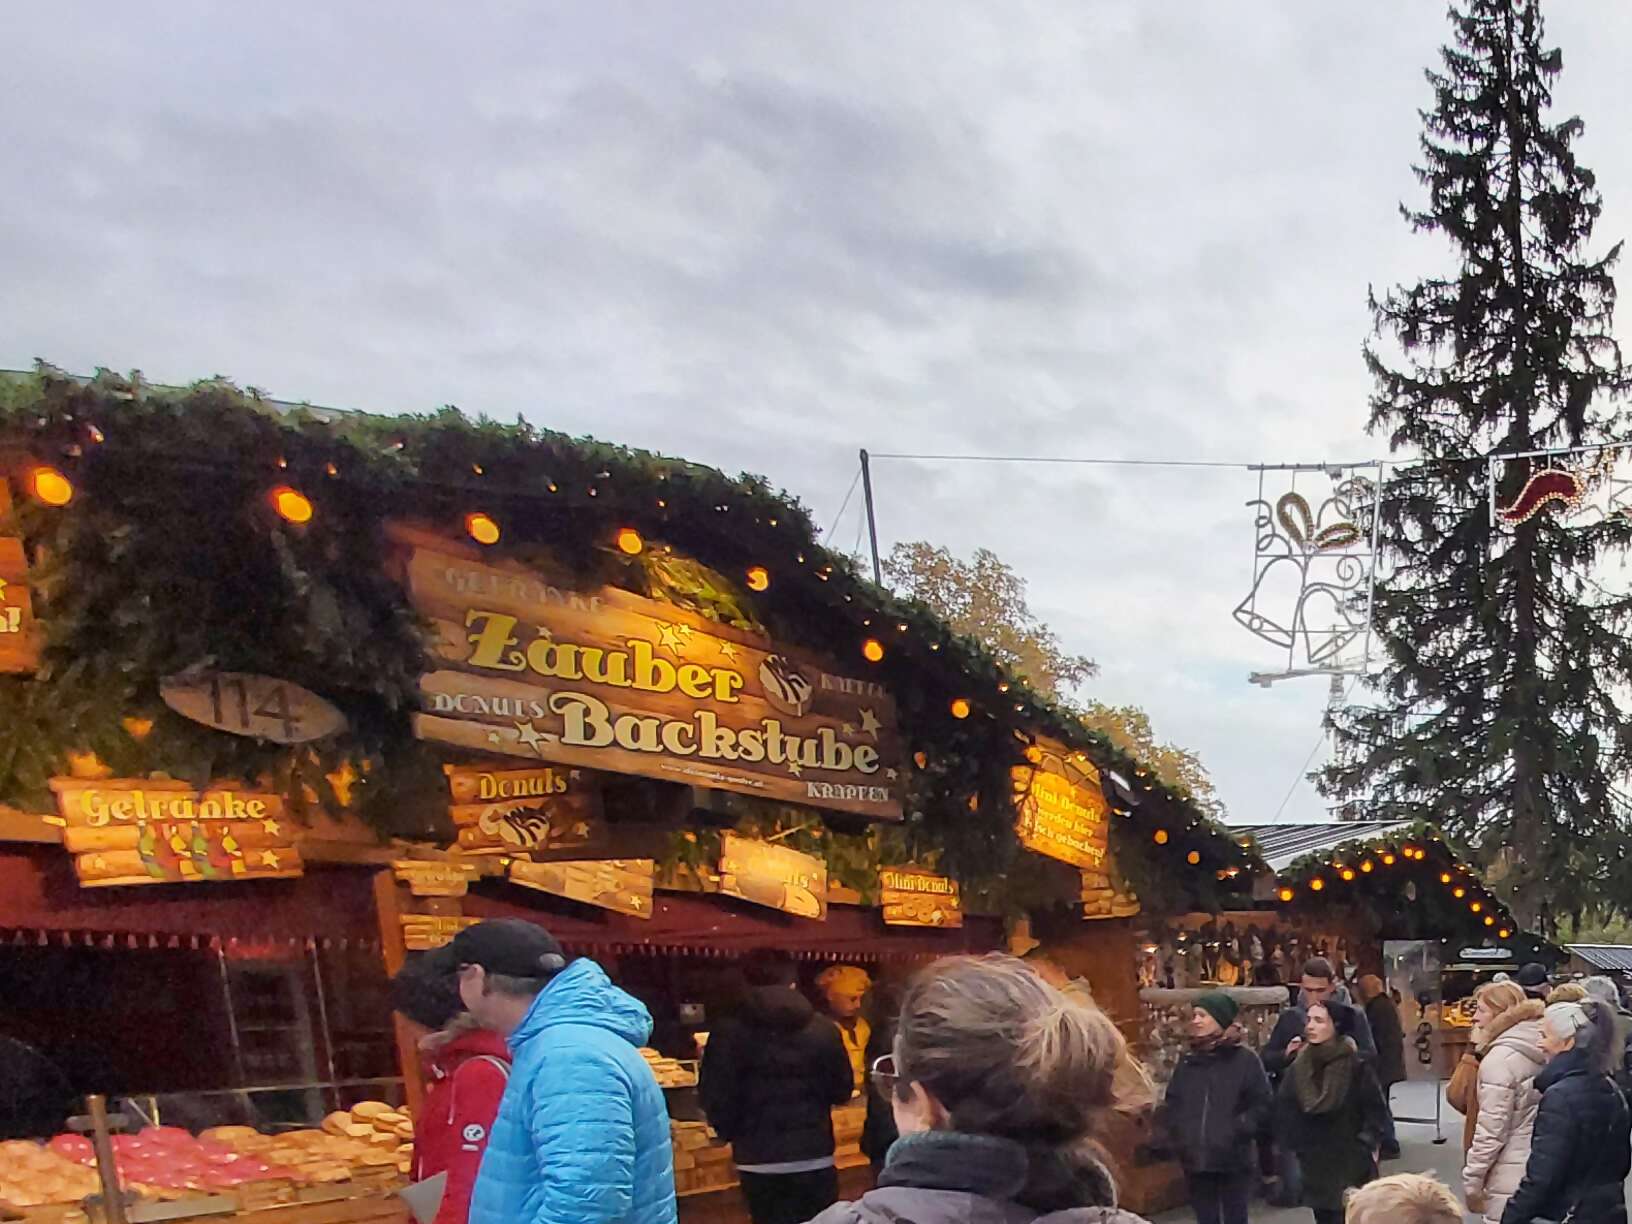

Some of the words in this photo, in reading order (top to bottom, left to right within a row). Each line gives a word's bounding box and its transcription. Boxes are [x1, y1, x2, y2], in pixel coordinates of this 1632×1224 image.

[465, 608, 744, 703] Zauber
[211, 679, 300, 738] 114
[433, 692, 545, 719] DONUTS
[549, 691, 880, 773] Backstube
[478, 768, 567, 799] Donuts
[807, 781, 889, 801] KRAPFEN
[80, 789, 266, 827] Getränke
